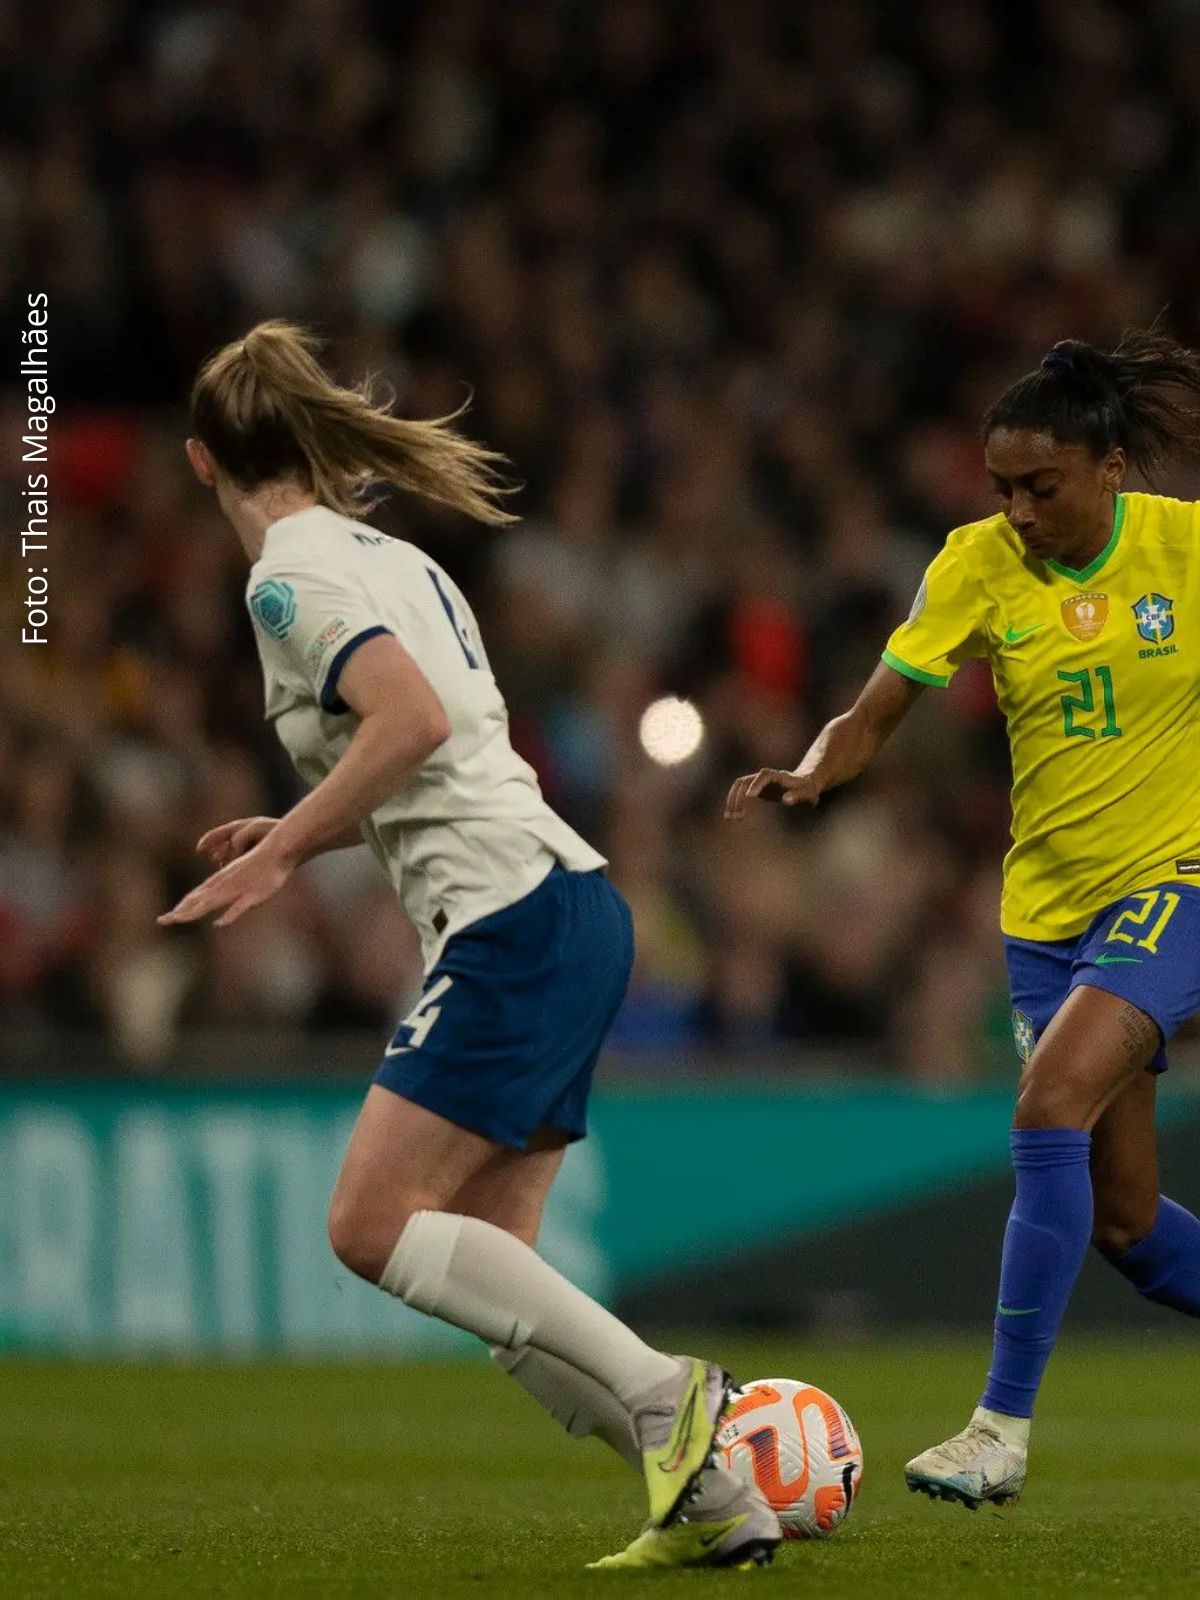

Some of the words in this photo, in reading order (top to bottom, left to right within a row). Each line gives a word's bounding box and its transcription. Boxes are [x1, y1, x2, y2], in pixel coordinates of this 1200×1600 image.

[1138, 645, 1179, 659] BRASIL
[1056, 665, 1123, 739] 21
[1105, 890, 1180, 954] 21
